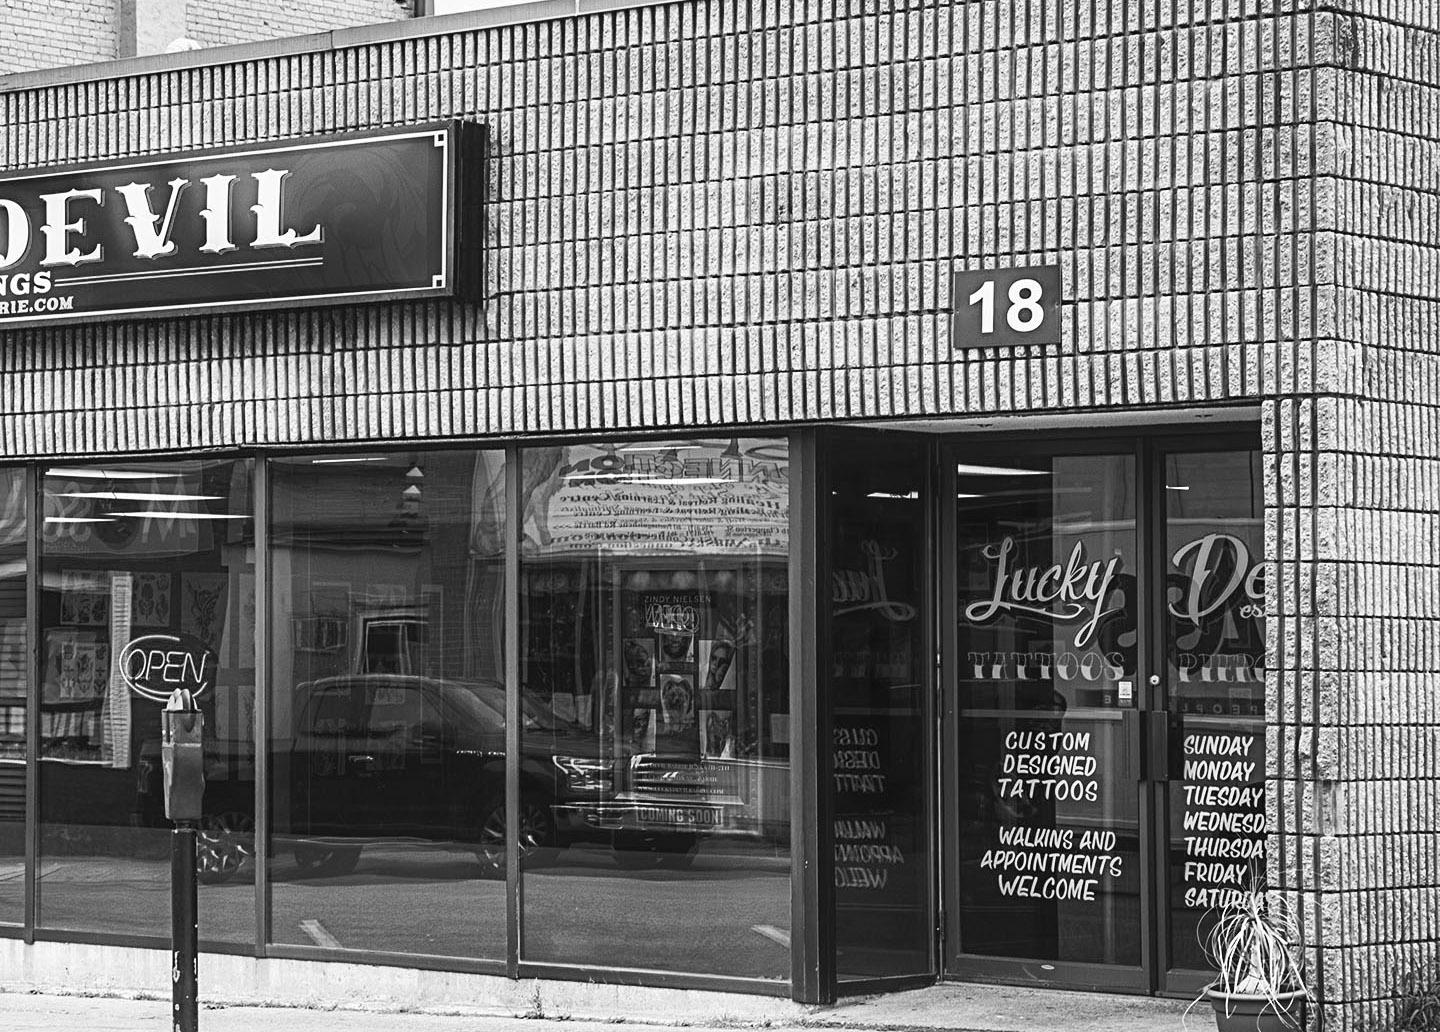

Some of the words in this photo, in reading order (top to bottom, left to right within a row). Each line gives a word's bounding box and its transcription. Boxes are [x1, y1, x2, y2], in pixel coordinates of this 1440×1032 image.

[969, 278, 1044, 333] 18
[965, 537, 1127, 647] Lucky
[125, 649, 209, 683] OPEN
[967, 652, 1125, 681] TATTOOS
[1005, 731, 1090, 751] CUSTOM
[1184, 735, 1254, 757] SUNDAY
[1003, 754, 1097, 776] DESIGNED
[1184, 760, 1256, 781] MONDAY
[998, 779, 1098, 801] TATTOOS
[1183, 786, 1264, 807] TUESDAY
[640, 807, 684, 822] COMING
[687, 808, 719, 824] SOON
[999, 826, 1073, 849] WALKINS
[1079, 830, 1116, 851] AND
[980, 850, 1122, 876] APPOINTMENTS
[1184, 862, 1247, 885] FRIDAY
[998, 874, 1098, 901] WELCOME
